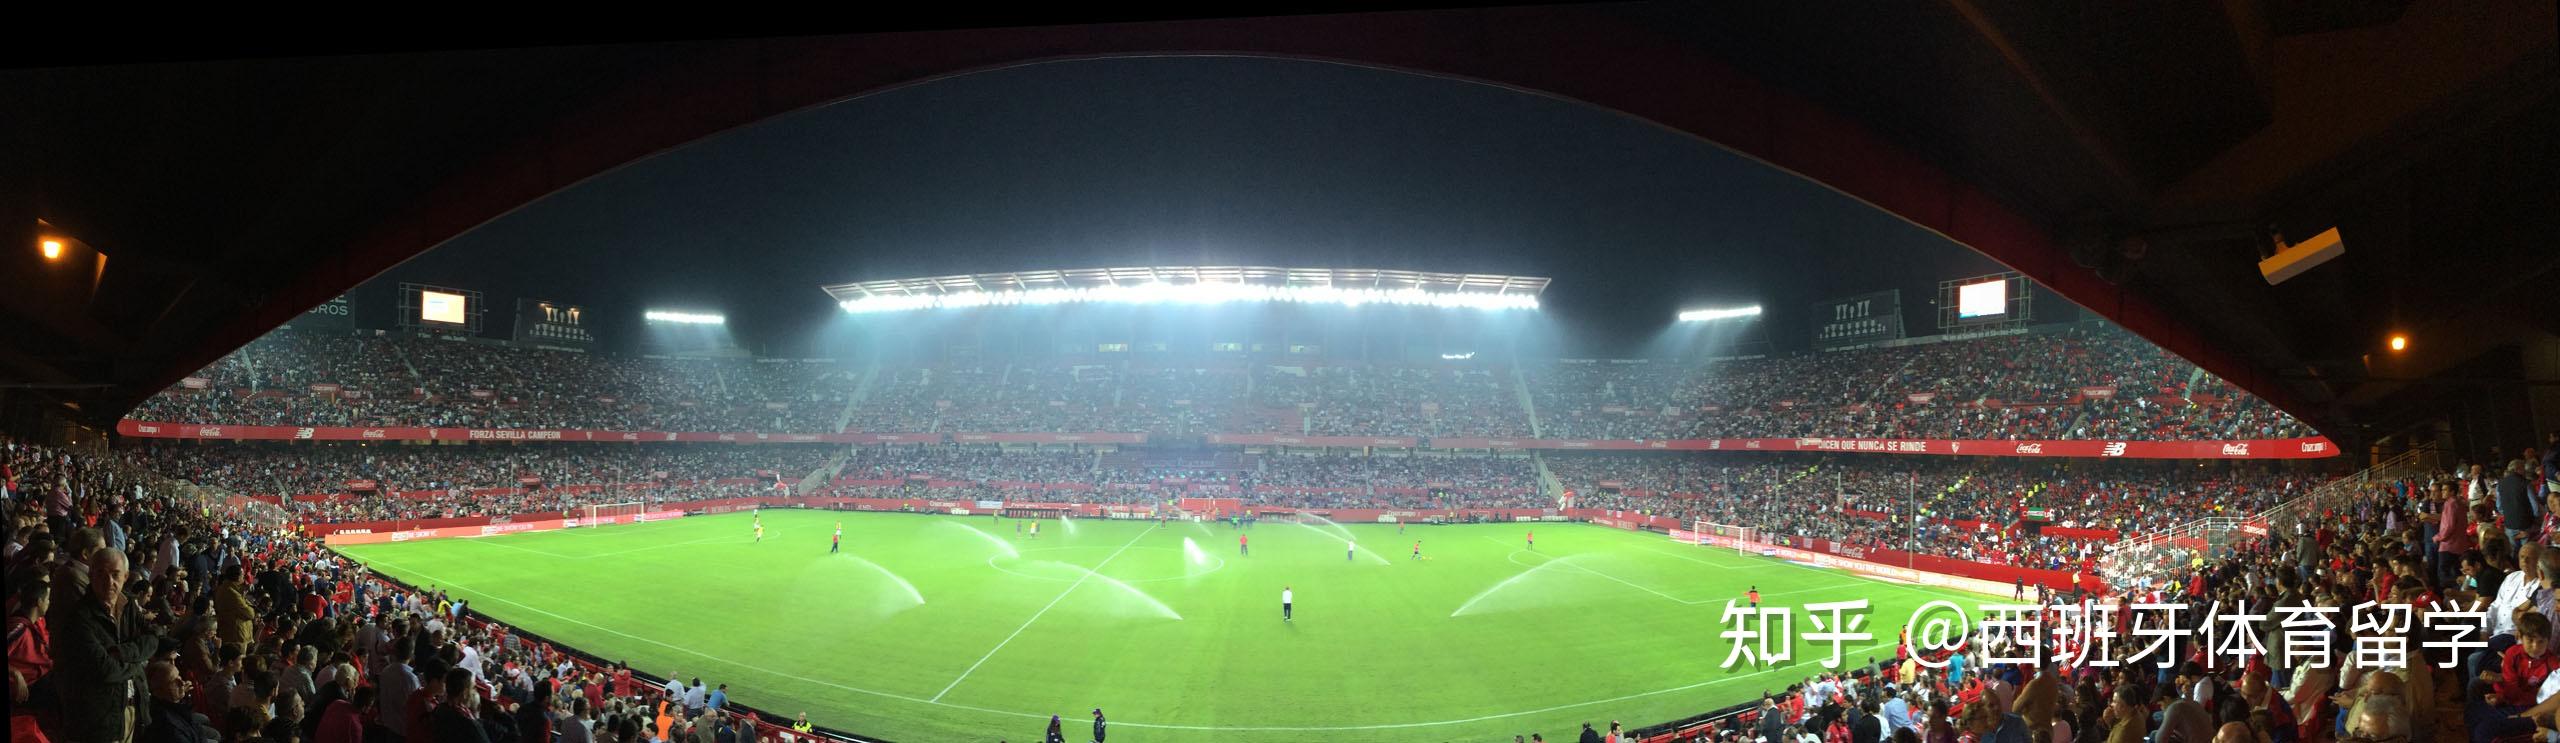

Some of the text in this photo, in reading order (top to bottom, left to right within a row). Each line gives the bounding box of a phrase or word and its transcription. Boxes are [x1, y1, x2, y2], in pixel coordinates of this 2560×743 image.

[470, 429, 561, 440] FORZA SEVILLA CAMPEON
[1841, 440, 1856, 450] QUE
[1858, 441, 1885, 451] NUNCA
[1887, 441, 1898, 451] SE
[1900, 441, 1927, 452] RINDE
